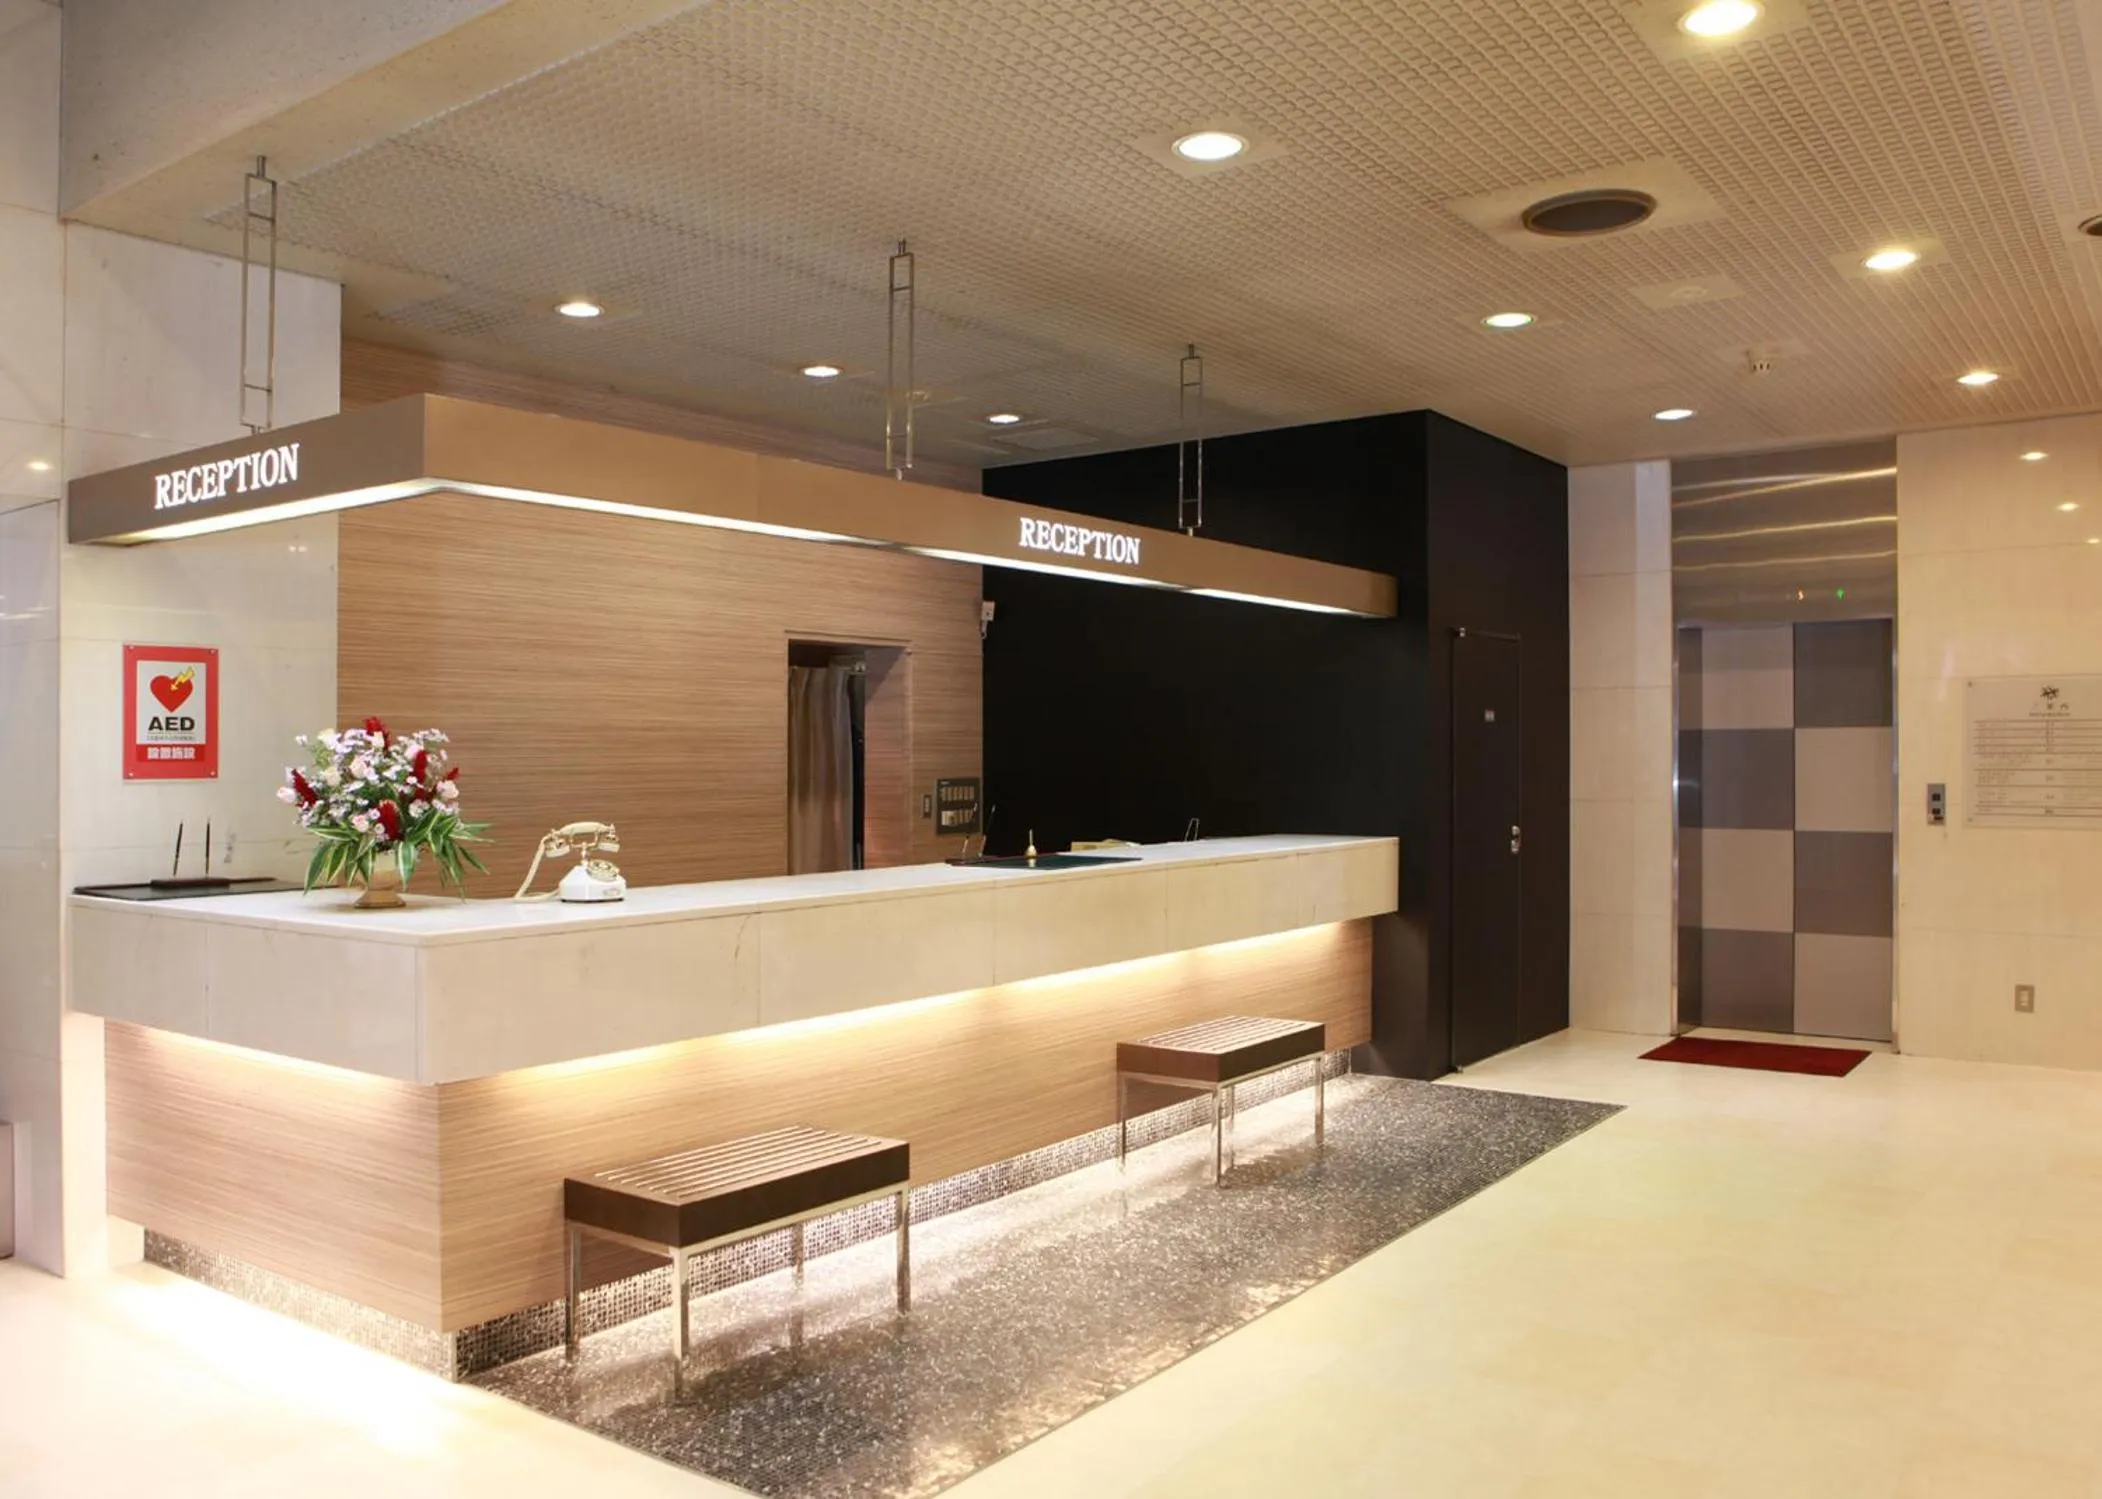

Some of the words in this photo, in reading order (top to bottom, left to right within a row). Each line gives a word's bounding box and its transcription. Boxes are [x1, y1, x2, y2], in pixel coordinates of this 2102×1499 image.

[154, 443, 300, 510] RECEPTION
[1018, 516, 1142, 565] RECEPTION
[148, 716, 195, 731] AED
